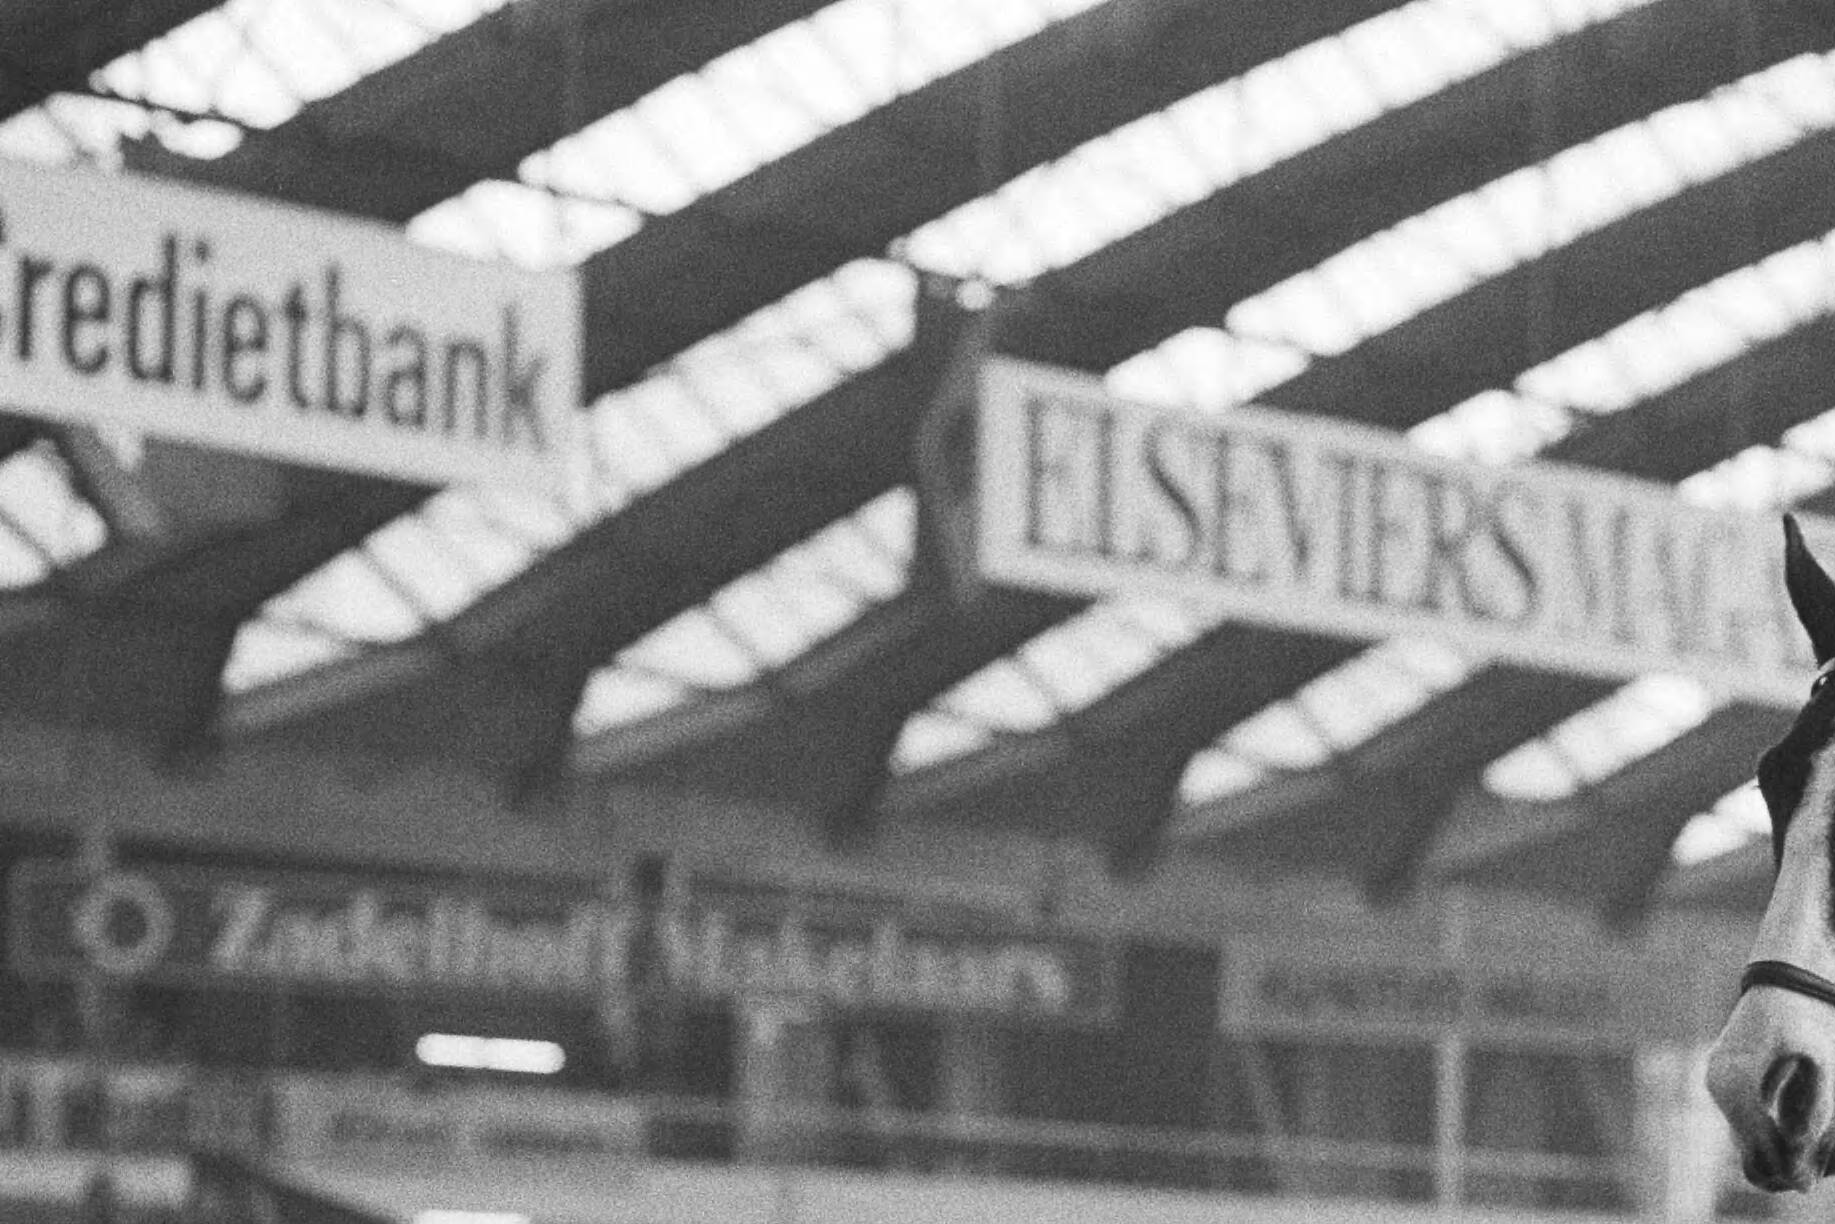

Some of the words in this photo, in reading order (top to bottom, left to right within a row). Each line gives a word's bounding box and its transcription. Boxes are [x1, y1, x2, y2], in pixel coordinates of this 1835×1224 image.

[0, 207, 547, 452] redietbank
[1025, 395, 1542, 628] ELSEVIERS
[211, 885, 627, 984] Zadelhoff
